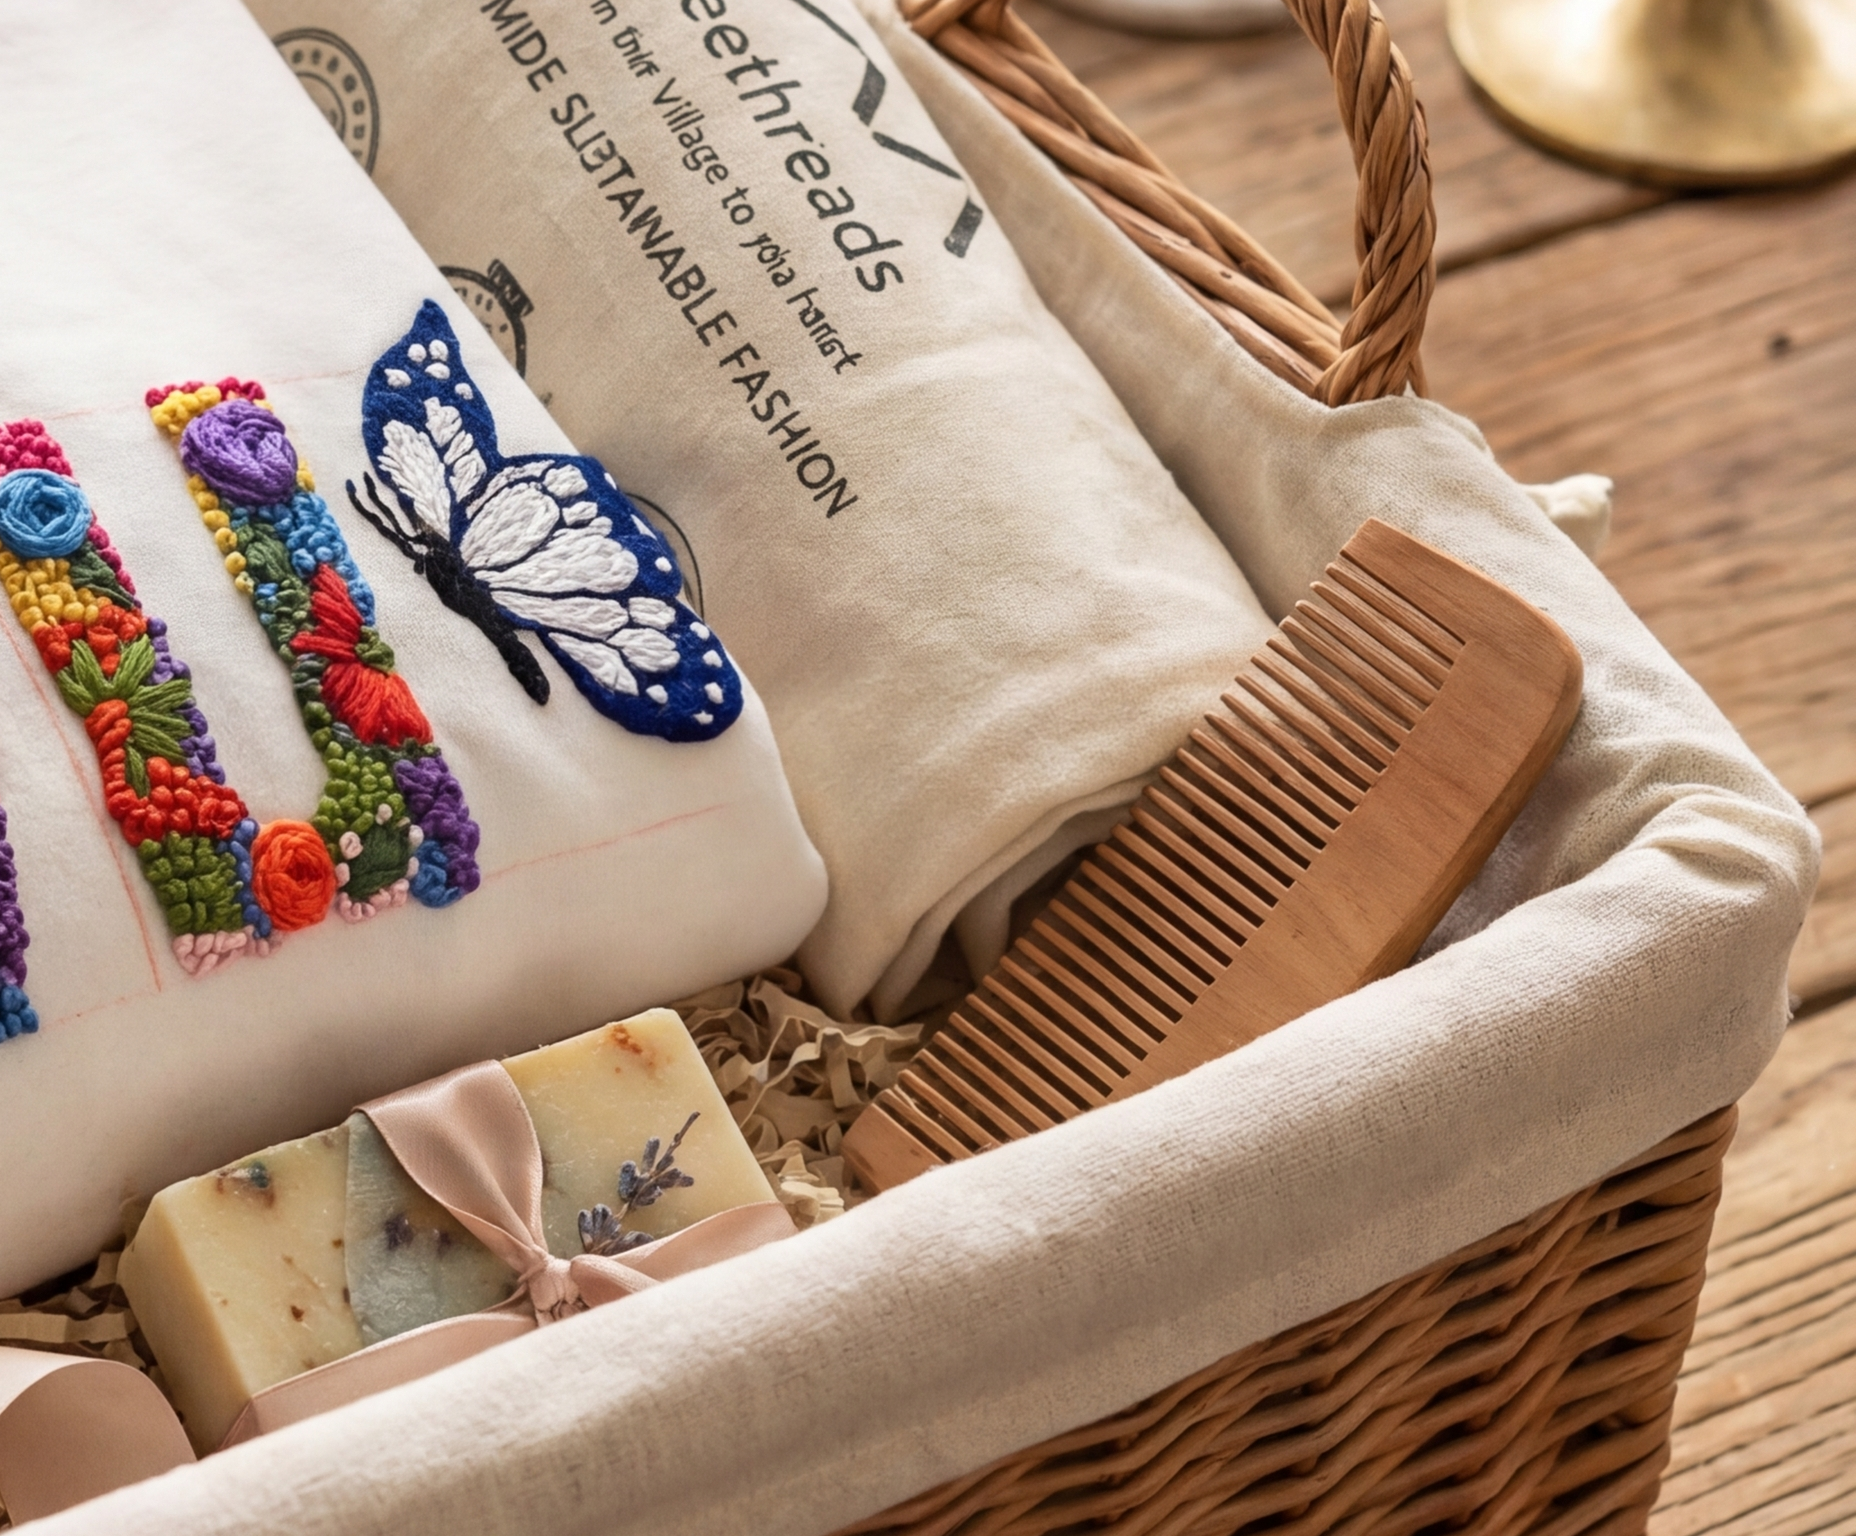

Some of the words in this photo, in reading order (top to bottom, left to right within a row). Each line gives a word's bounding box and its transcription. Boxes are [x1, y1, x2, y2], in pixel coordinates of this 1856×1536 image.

[653, 77, 729, 184] Village
[721, 186, 755, 225] to
[719, 342, 858, 518] FASHION
